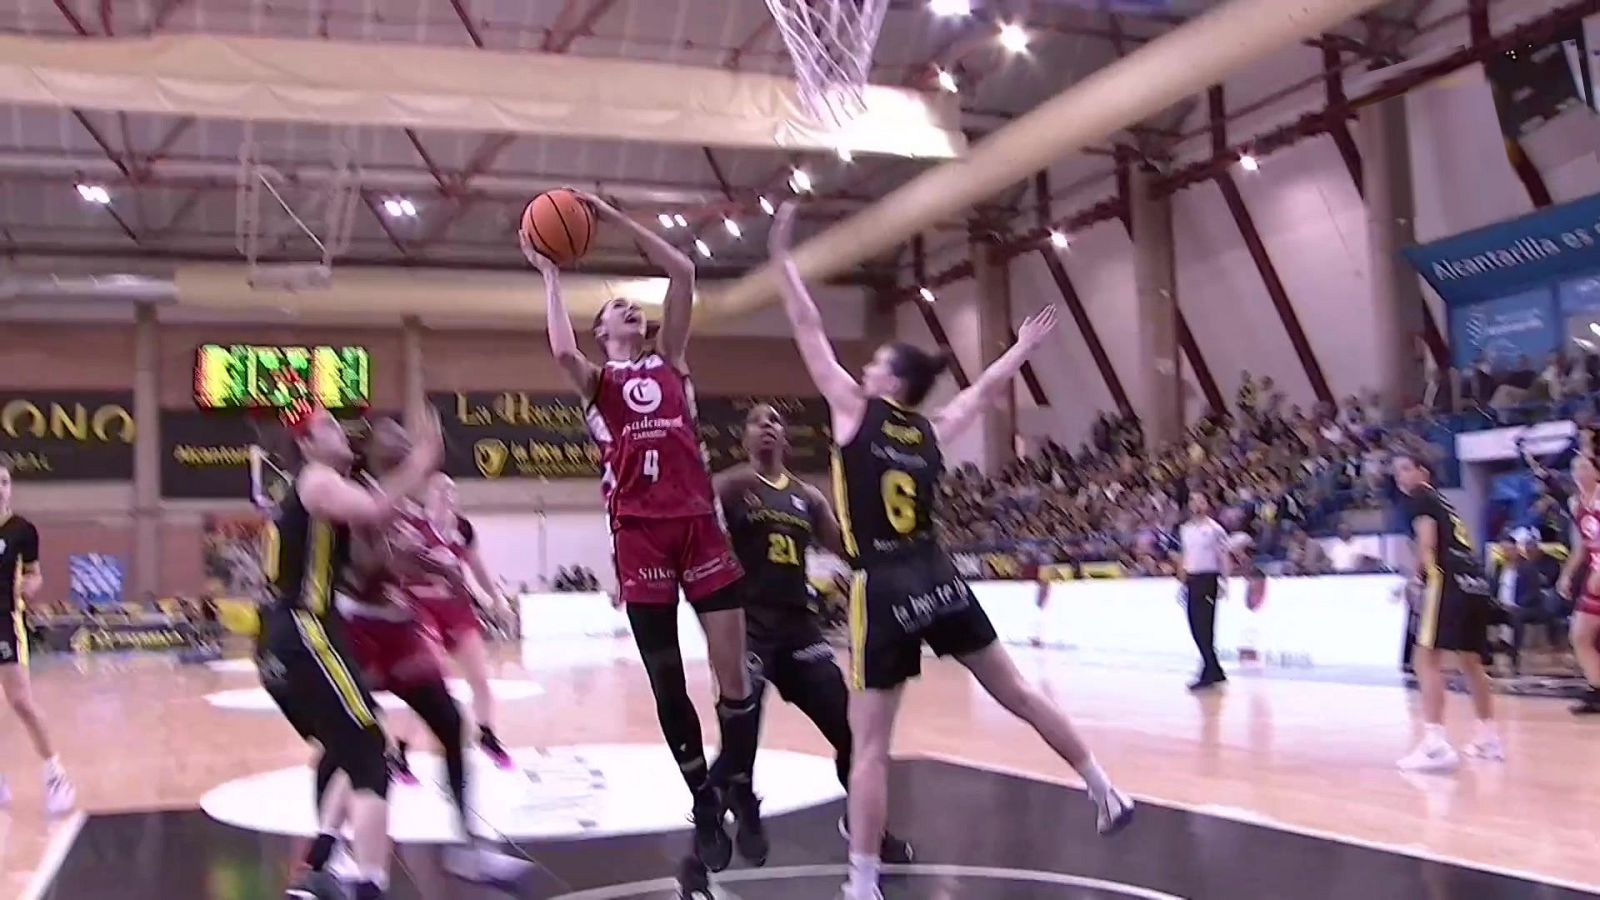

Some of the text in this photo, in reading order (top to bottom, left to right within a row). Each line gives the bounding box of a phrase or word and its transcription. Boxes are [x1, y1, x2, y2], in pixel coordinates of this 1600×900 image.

[1431, 228, 1594, 281] Alcantarilla es
[643, 449, 660, 484] 4
[880, 468, 917, 535] 6
[767, 532, 800, 567] 21
